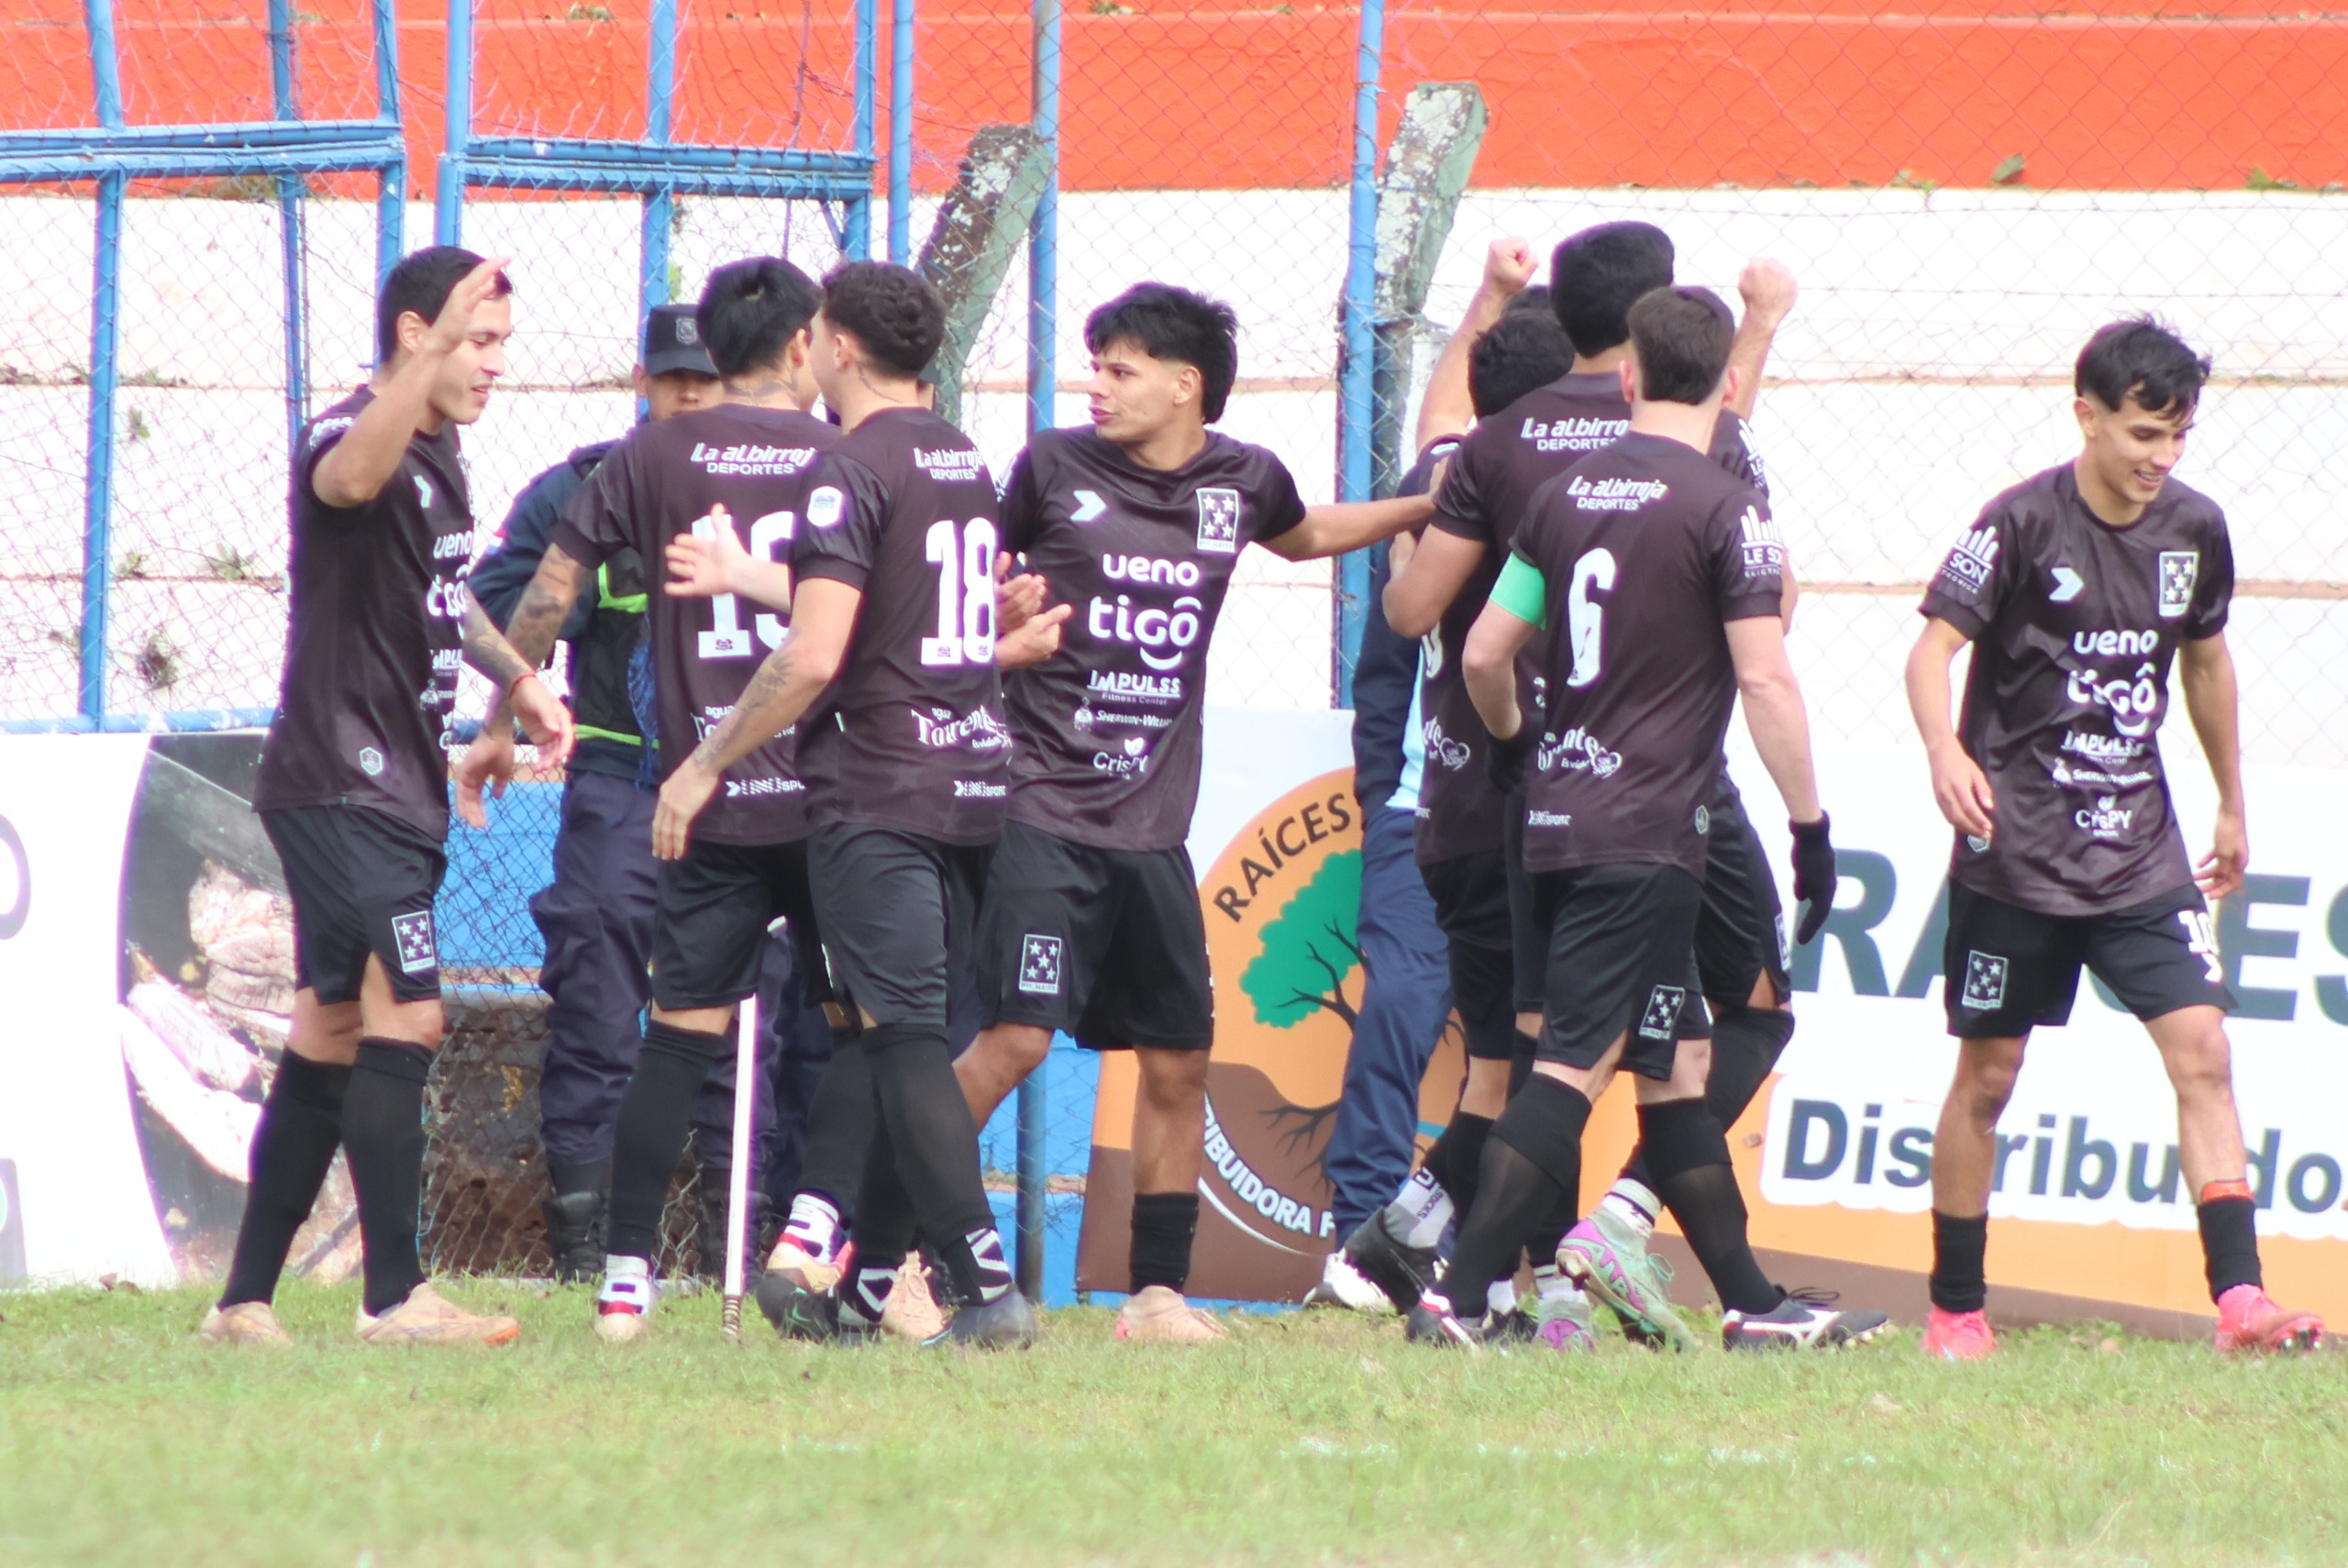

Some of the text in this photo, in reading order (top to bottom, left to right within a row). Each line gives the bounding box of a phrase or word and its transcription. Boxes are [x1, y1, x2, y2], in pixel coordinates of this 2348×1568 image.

[1550, 417, 1630, 437] albirro
[706, 462, 796, 475] DEPORTES
[721, 444, 816, 468] albirroj
[929, 468, 977, 480] DEPORTES
[1576, 497, 1641, 511] DEPORTES
[433, 530, 473, 559] ueno
[1744, 547, 1782, 565] LE SO
[1102, 553, 1200, 587] ueno
[920, 516, 997, 666] 18
[1566, 547, 1617, 687] 6
[2074, 629, 2160, 655] ueno
[1088, 669, 1181, 695] IMPULSS
[1213, 792, 1351, 923] RAÍCES
[1782, 1099, 2342, 1212] Disribudo
